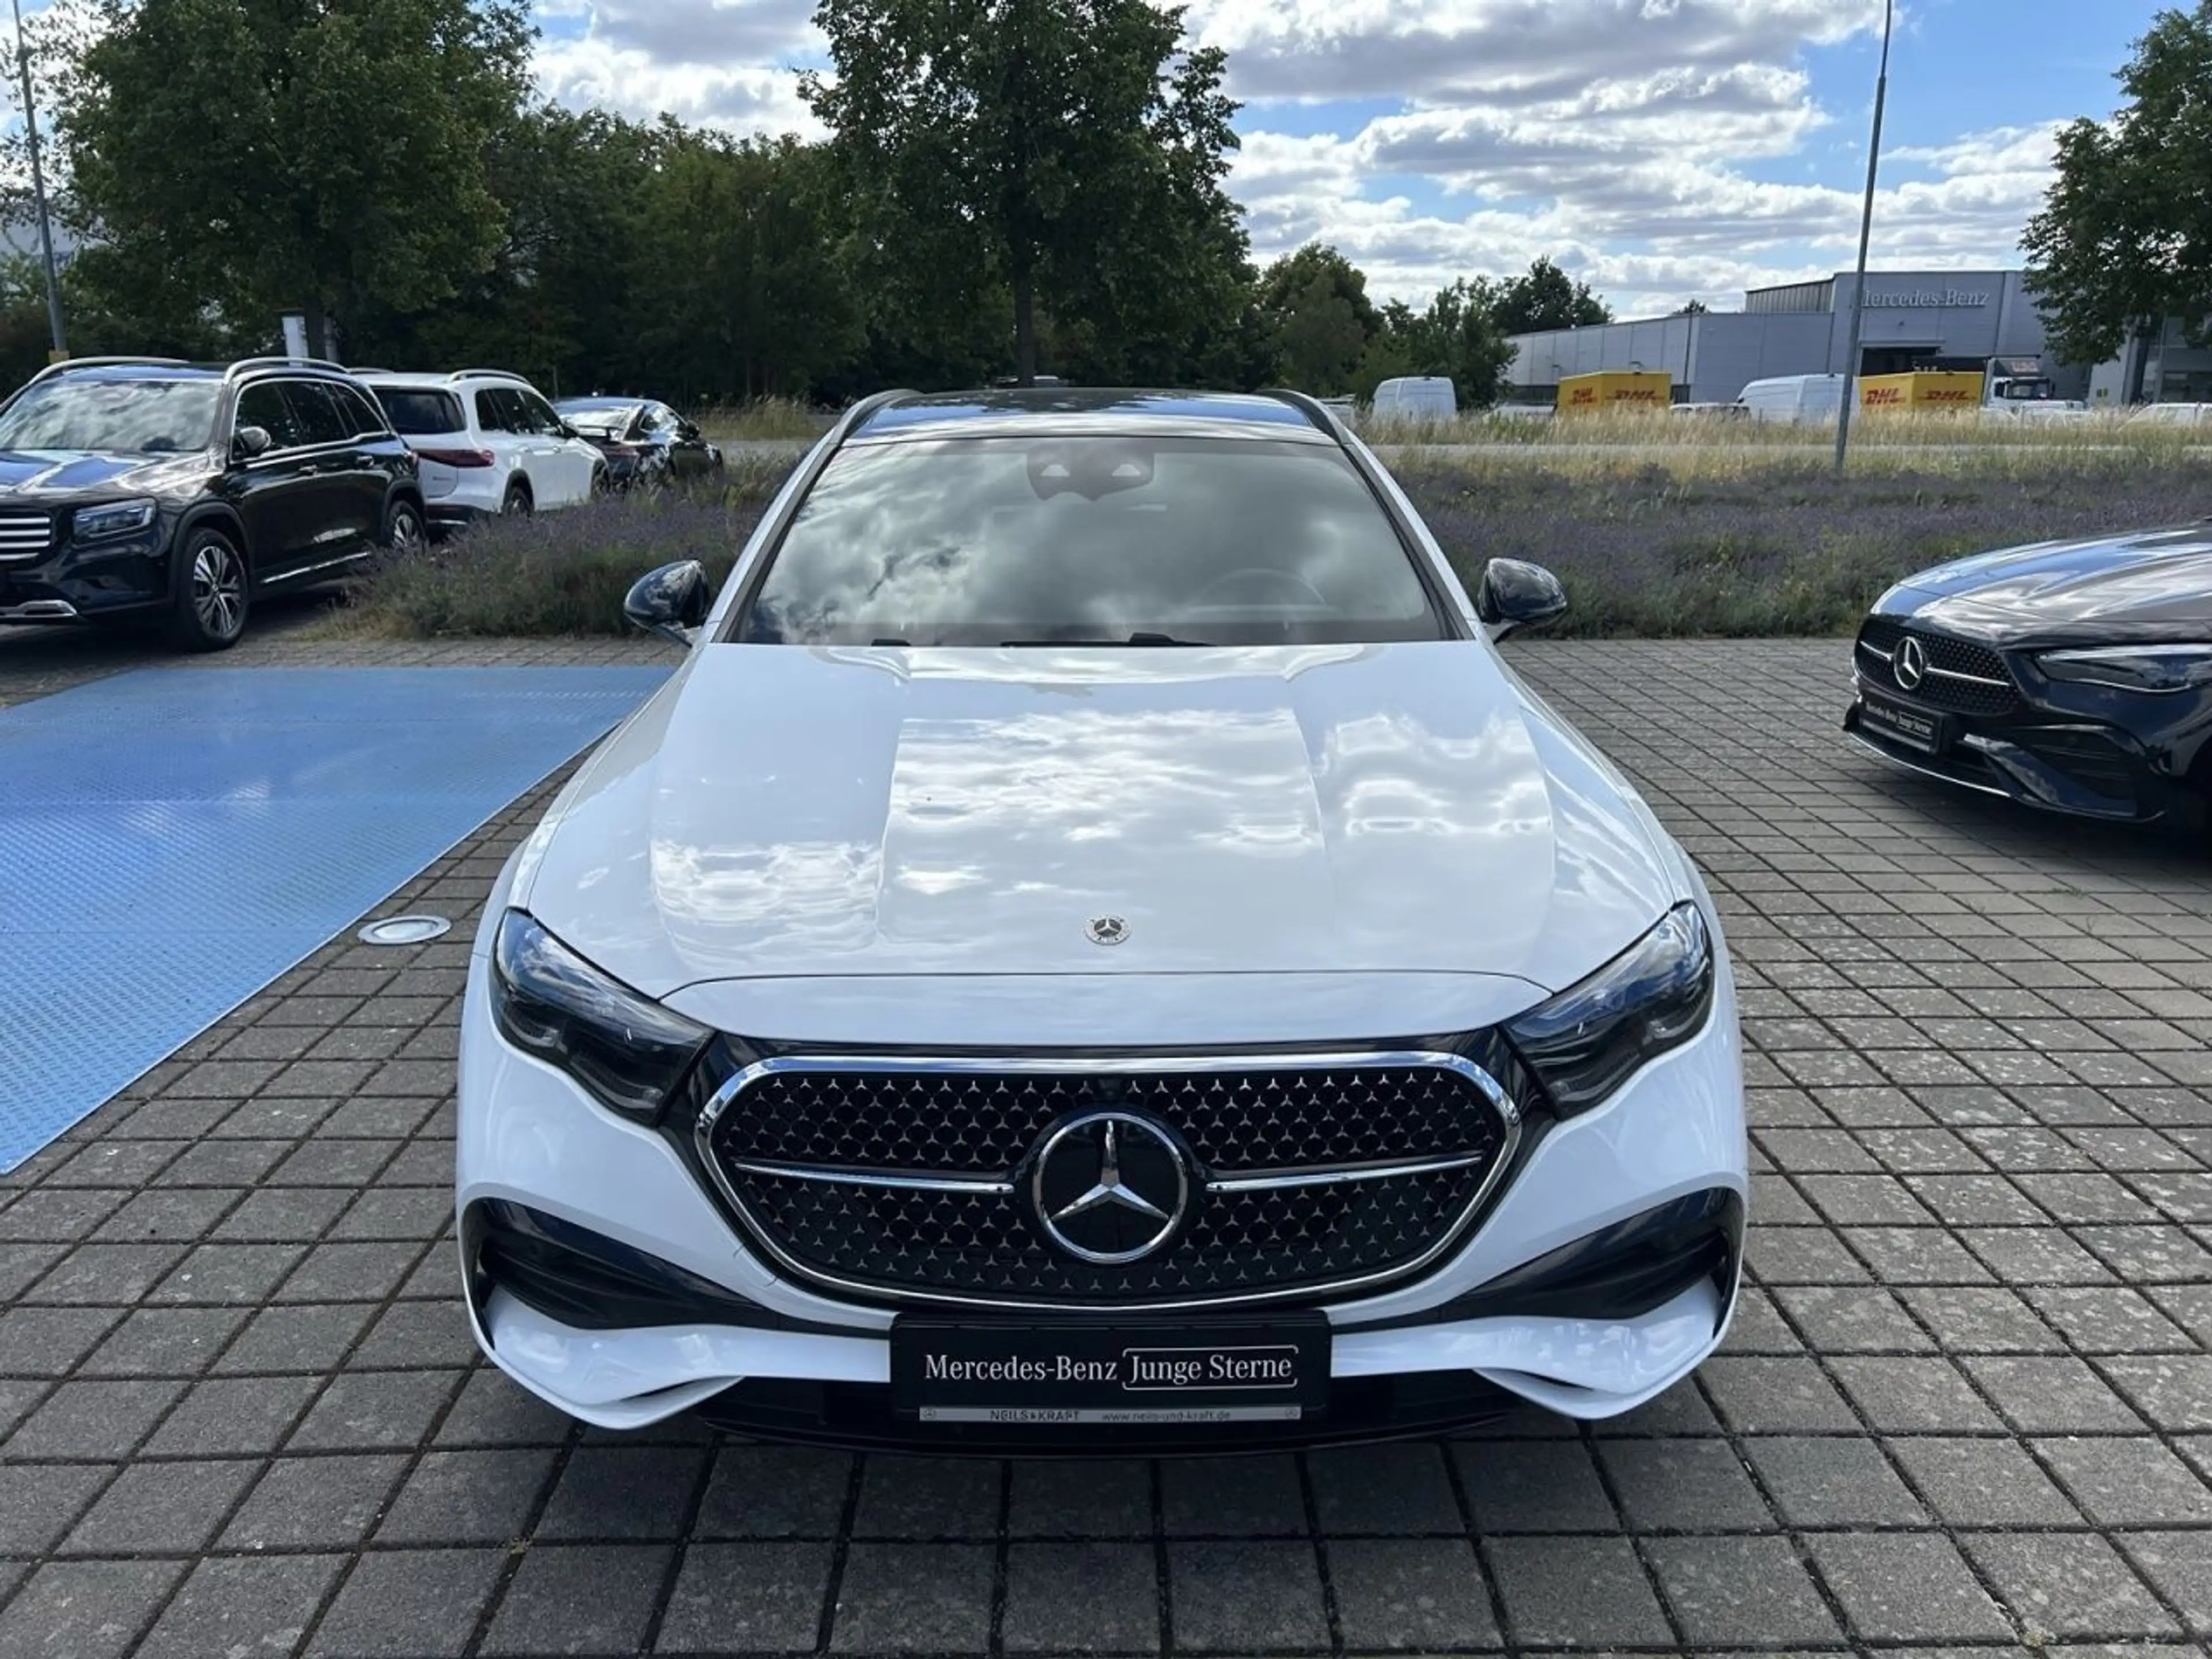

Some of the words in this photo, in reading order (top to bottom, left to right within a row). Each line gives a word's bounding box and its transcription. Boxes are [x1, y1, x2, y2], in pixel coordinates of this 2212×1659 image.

[1866, 388, 1900, 404] DHL
[1925, 390, 1968, 400] DHL
[925, 1354, 1118, 1380] Mercedes-Benz
[1130, 1355, 1202, 1385] Junge
[1209, 1353, 1293, 1379] Sterne
